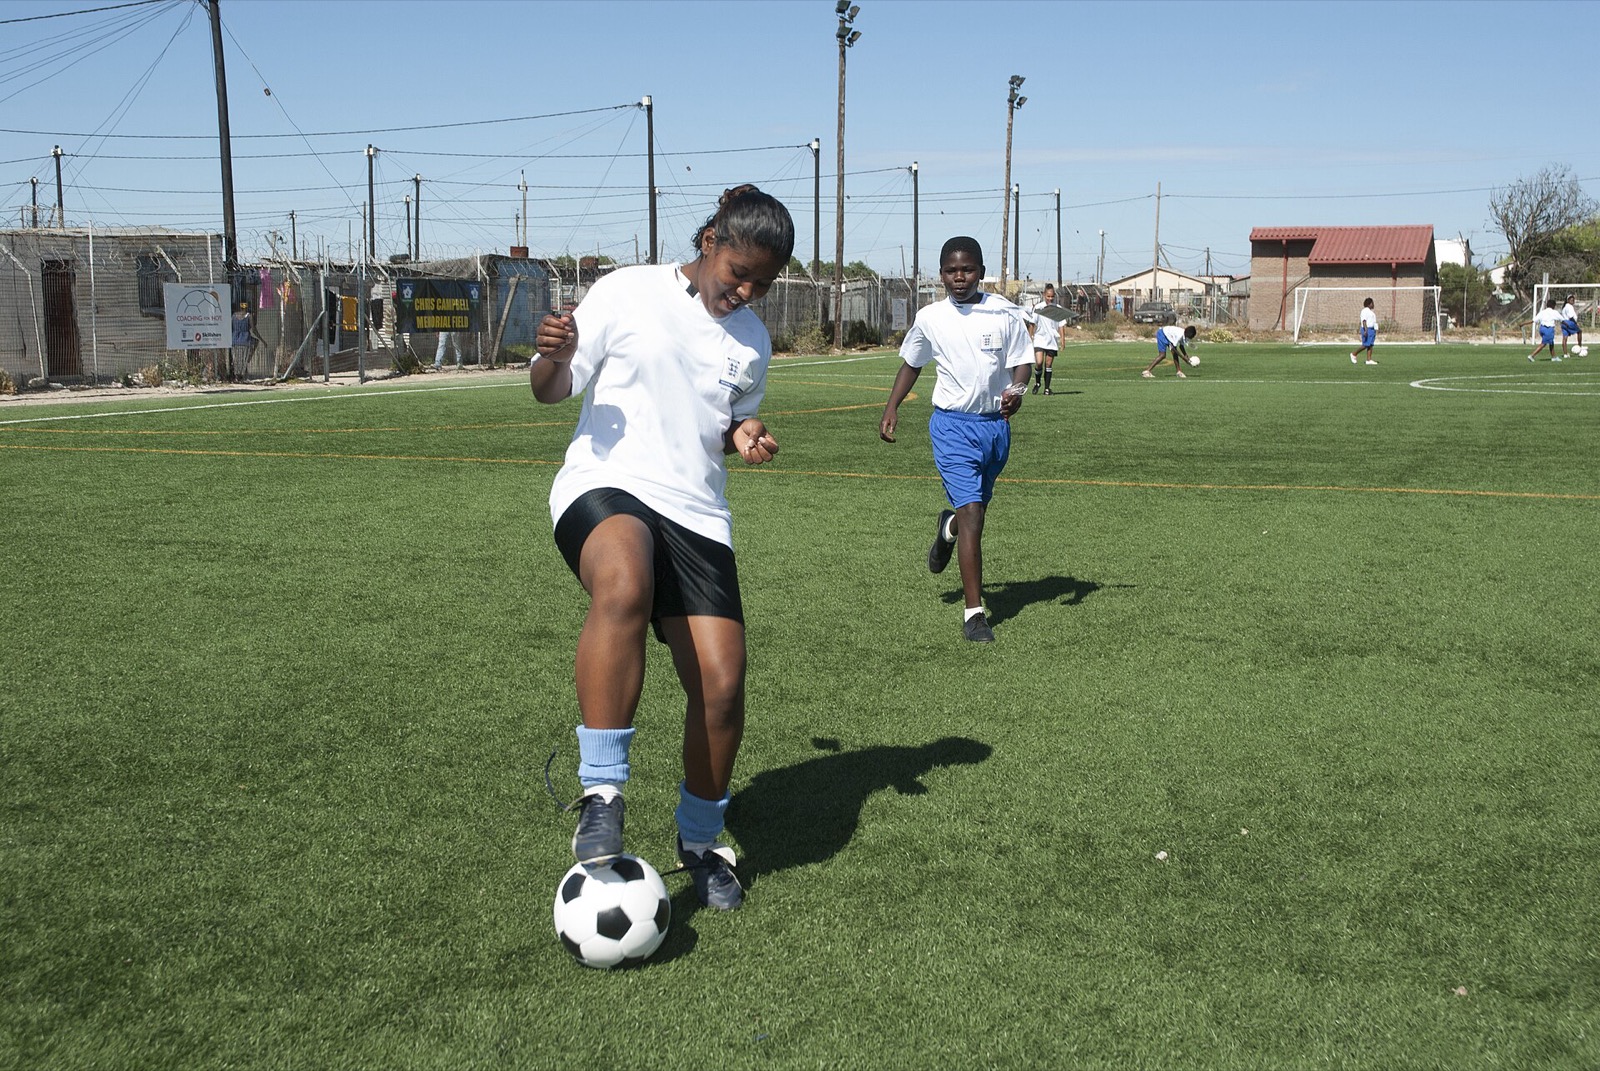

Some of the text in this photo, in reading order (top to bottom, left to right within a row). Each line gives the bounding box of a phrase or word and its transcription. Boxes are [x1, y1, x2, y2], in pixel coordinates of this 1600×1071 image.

[414, 298, 470, 311] CHRIS CAMPBELL
[416, 315, 469, 329] MEMORIAL FIELD
